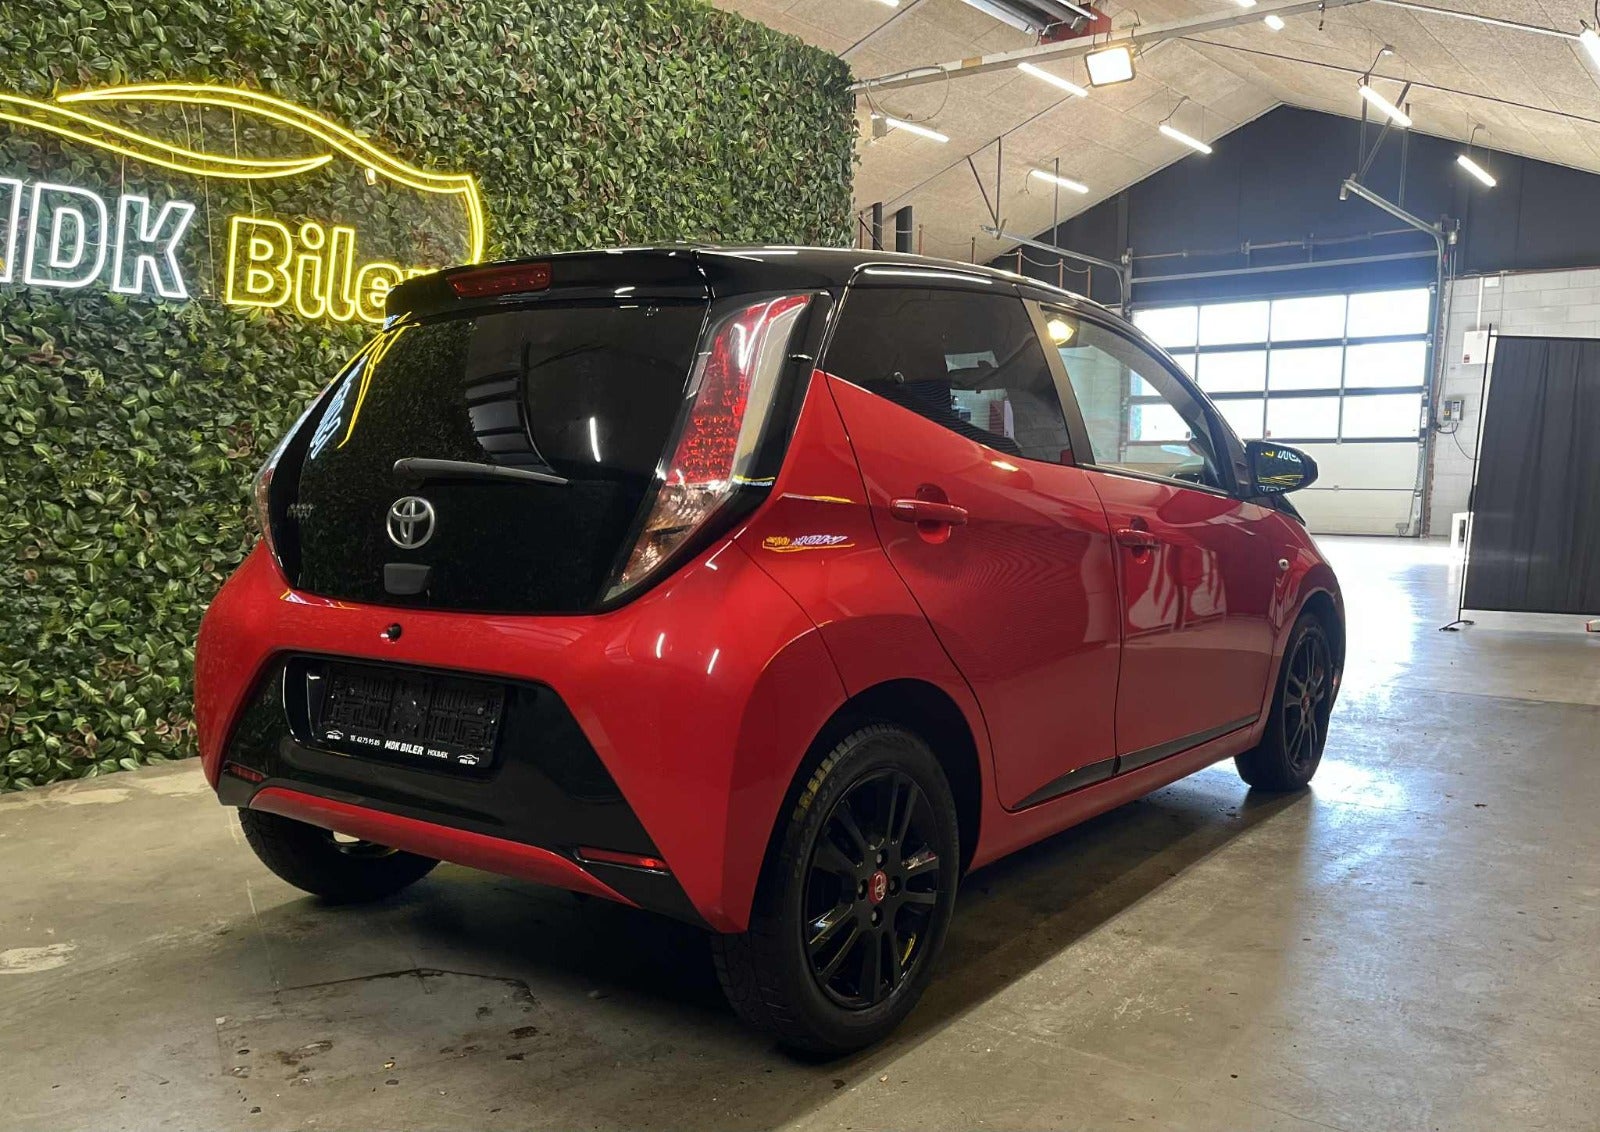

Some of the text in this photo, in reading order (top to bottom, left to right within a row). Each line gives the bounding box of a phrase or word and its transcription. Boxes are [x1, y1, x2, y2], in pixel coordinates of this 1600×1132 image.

[226, 215, 440, 323] Bile
[384, 740, 400, 750] MDK
[400, 743, 424, 755] BILER
